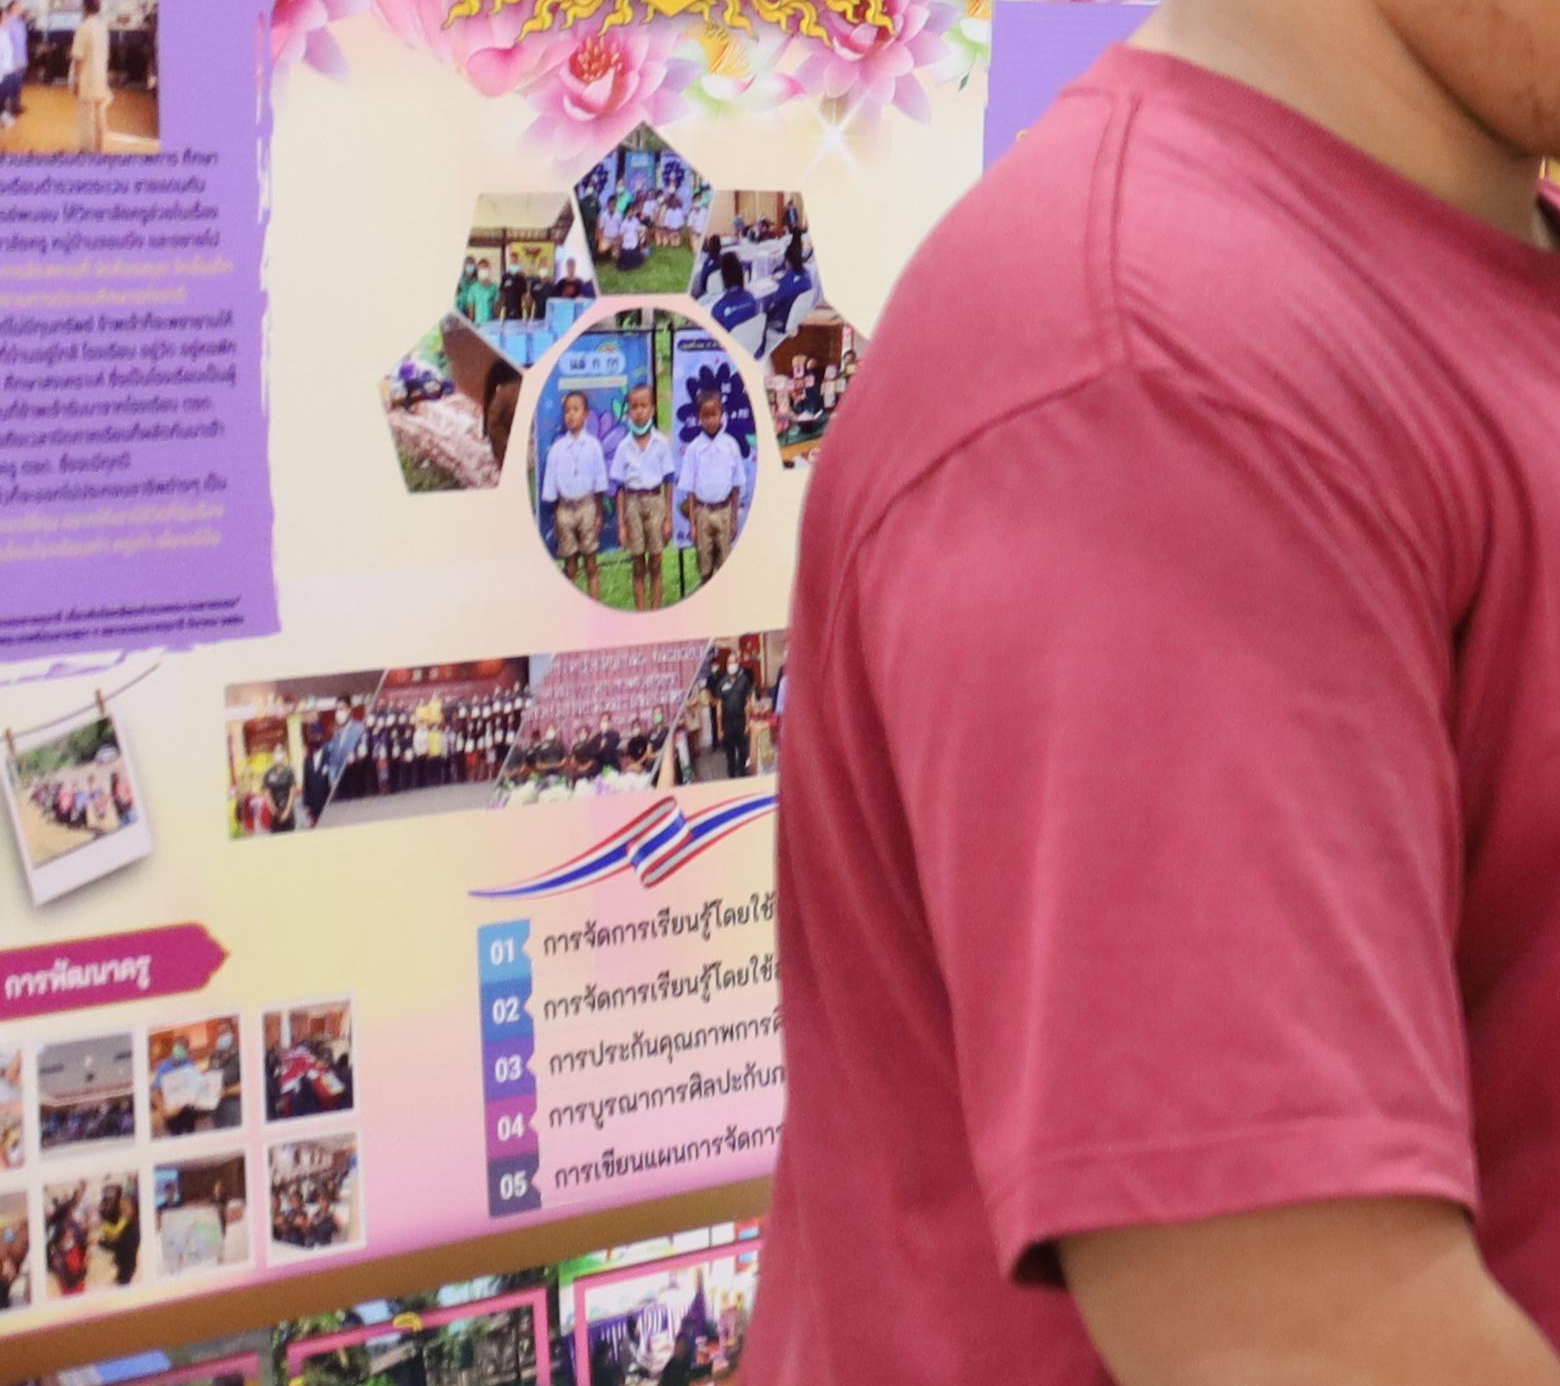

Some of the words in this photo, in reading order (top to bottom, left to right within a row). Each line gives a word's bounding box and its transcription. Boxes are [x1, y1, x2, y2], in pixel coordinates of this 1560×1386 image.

[489, 938, 515, 965] 01
[4, 954, 152, 1001] การพัฒนาครู
[491, 996, 520, 1025] 02
[542, 953, 781, 1020] การจัดการเรียนรู้โดยใช้
[494, 1054, 523, 1084] 03
[497, 1113, 525, 1142] 04
[499, 1170, 528, 1201] 05
